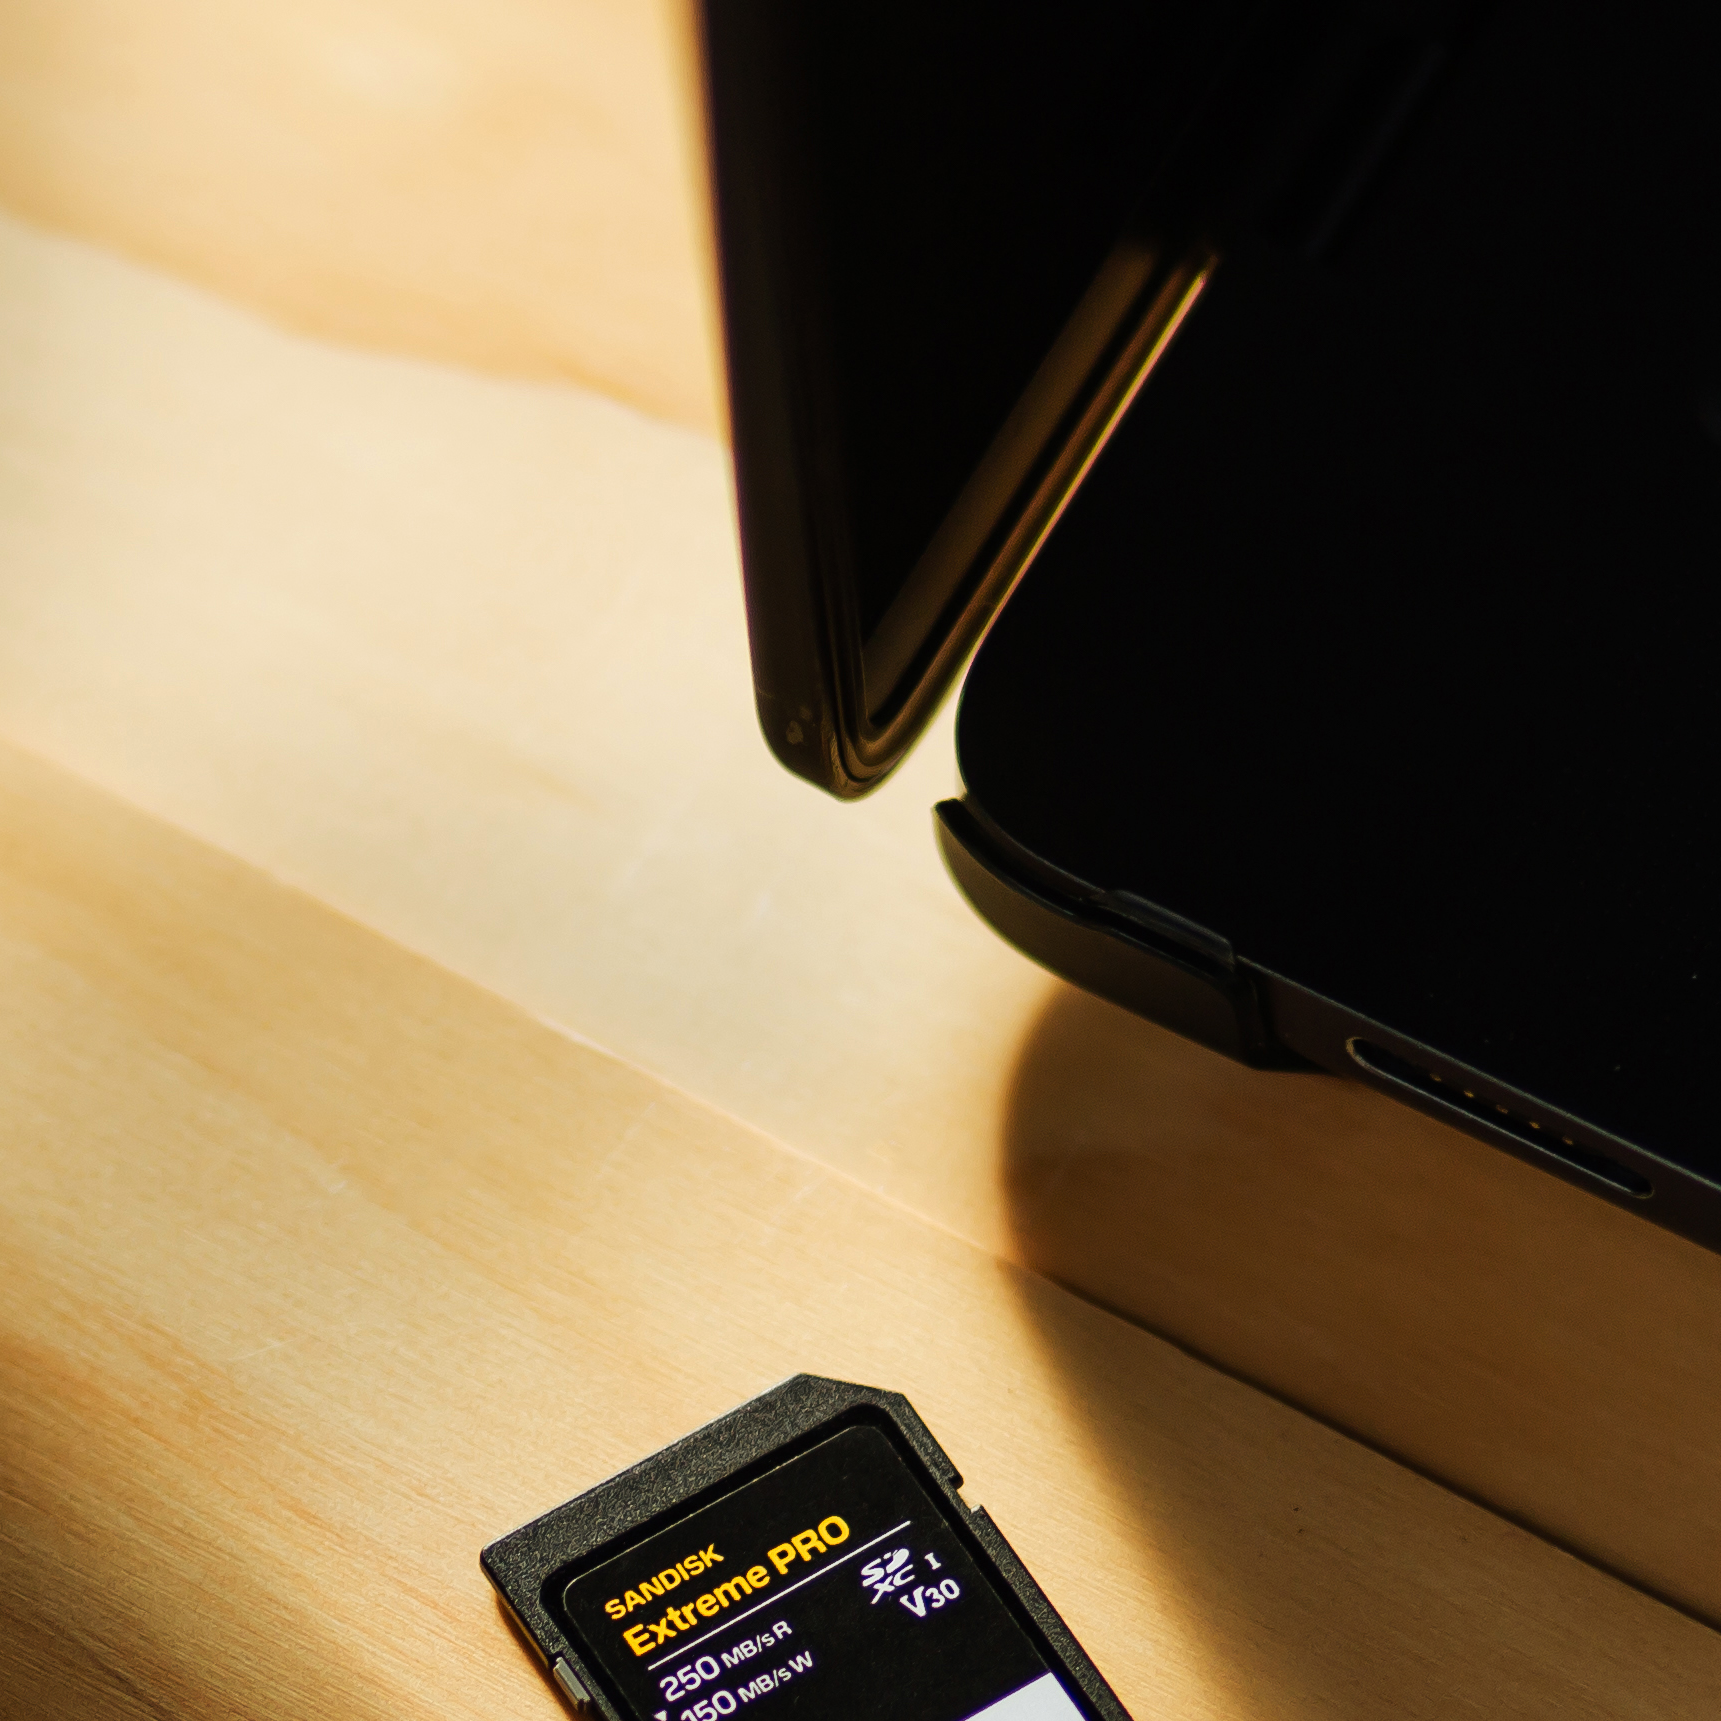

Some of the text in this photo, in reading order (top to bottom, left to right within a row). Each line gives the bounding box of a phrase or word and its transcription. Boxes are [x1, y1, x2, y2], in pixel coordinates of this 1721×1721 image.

[604, 1543, 725, 1620] SANDISK
[622, 1515, 850, 1657] Extreme PRO
[899, 1578, 961, 1618] V30
[659, 1655, 721, 1702] 250
